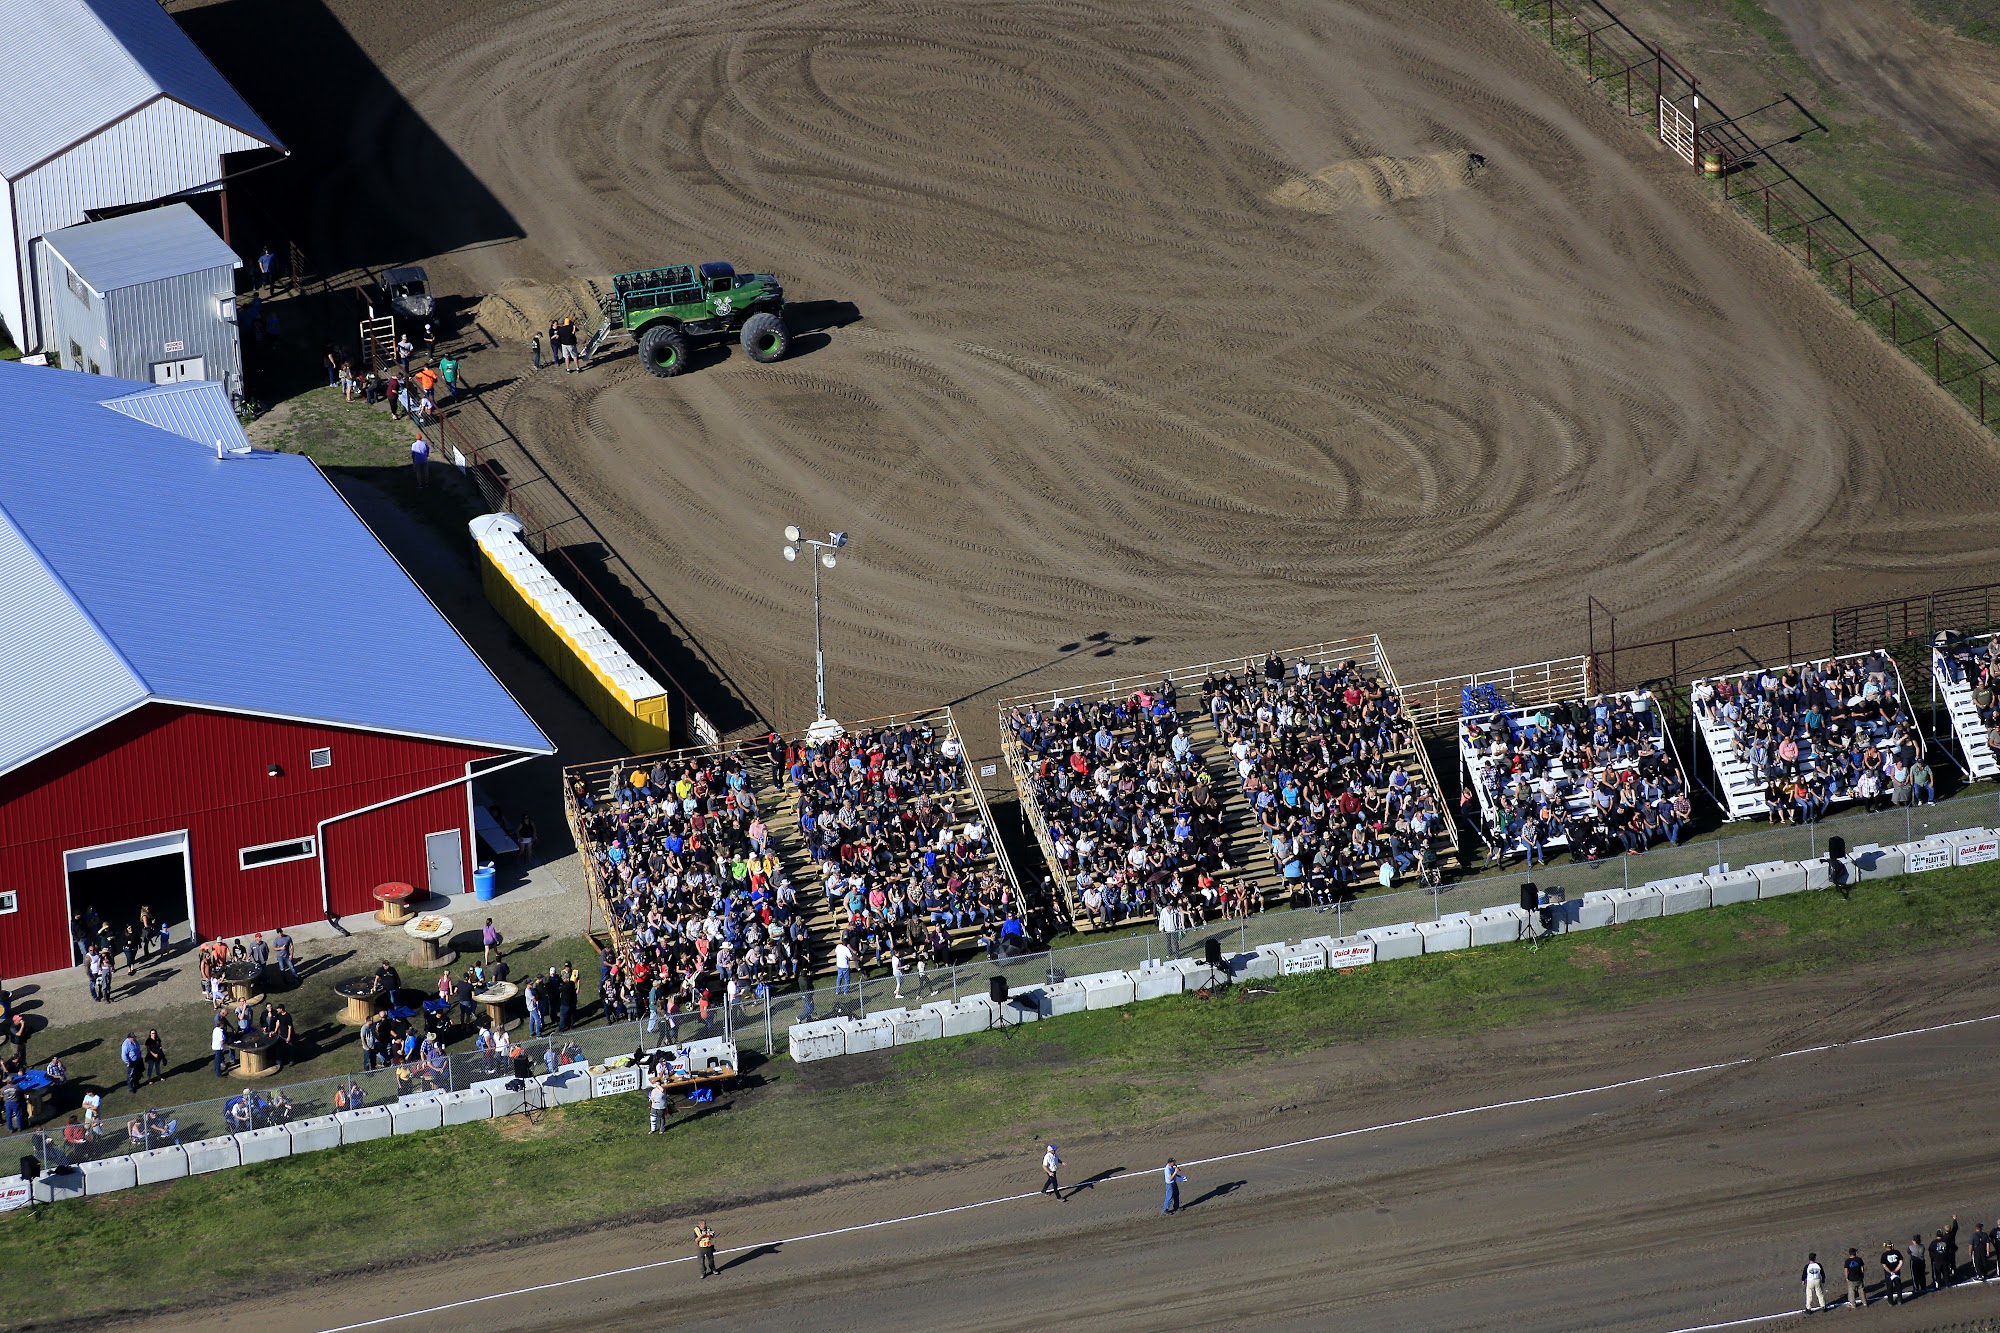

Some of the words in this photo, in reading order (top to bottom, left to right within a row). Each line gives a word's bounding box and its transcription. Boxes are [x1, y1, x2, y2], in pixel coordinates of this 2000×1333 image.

[1961, 846, 1977, 855] Quick
[1978, 843, 1996, 851] Moves
[1925, 856, 1939, 864] READY
[1334, 948, 1350, 958] Quick
[1299, 960, 1313, 969] READY
[612, 1079, 626, 1087] READY
[7, 1189, 26, 1197] Moves
